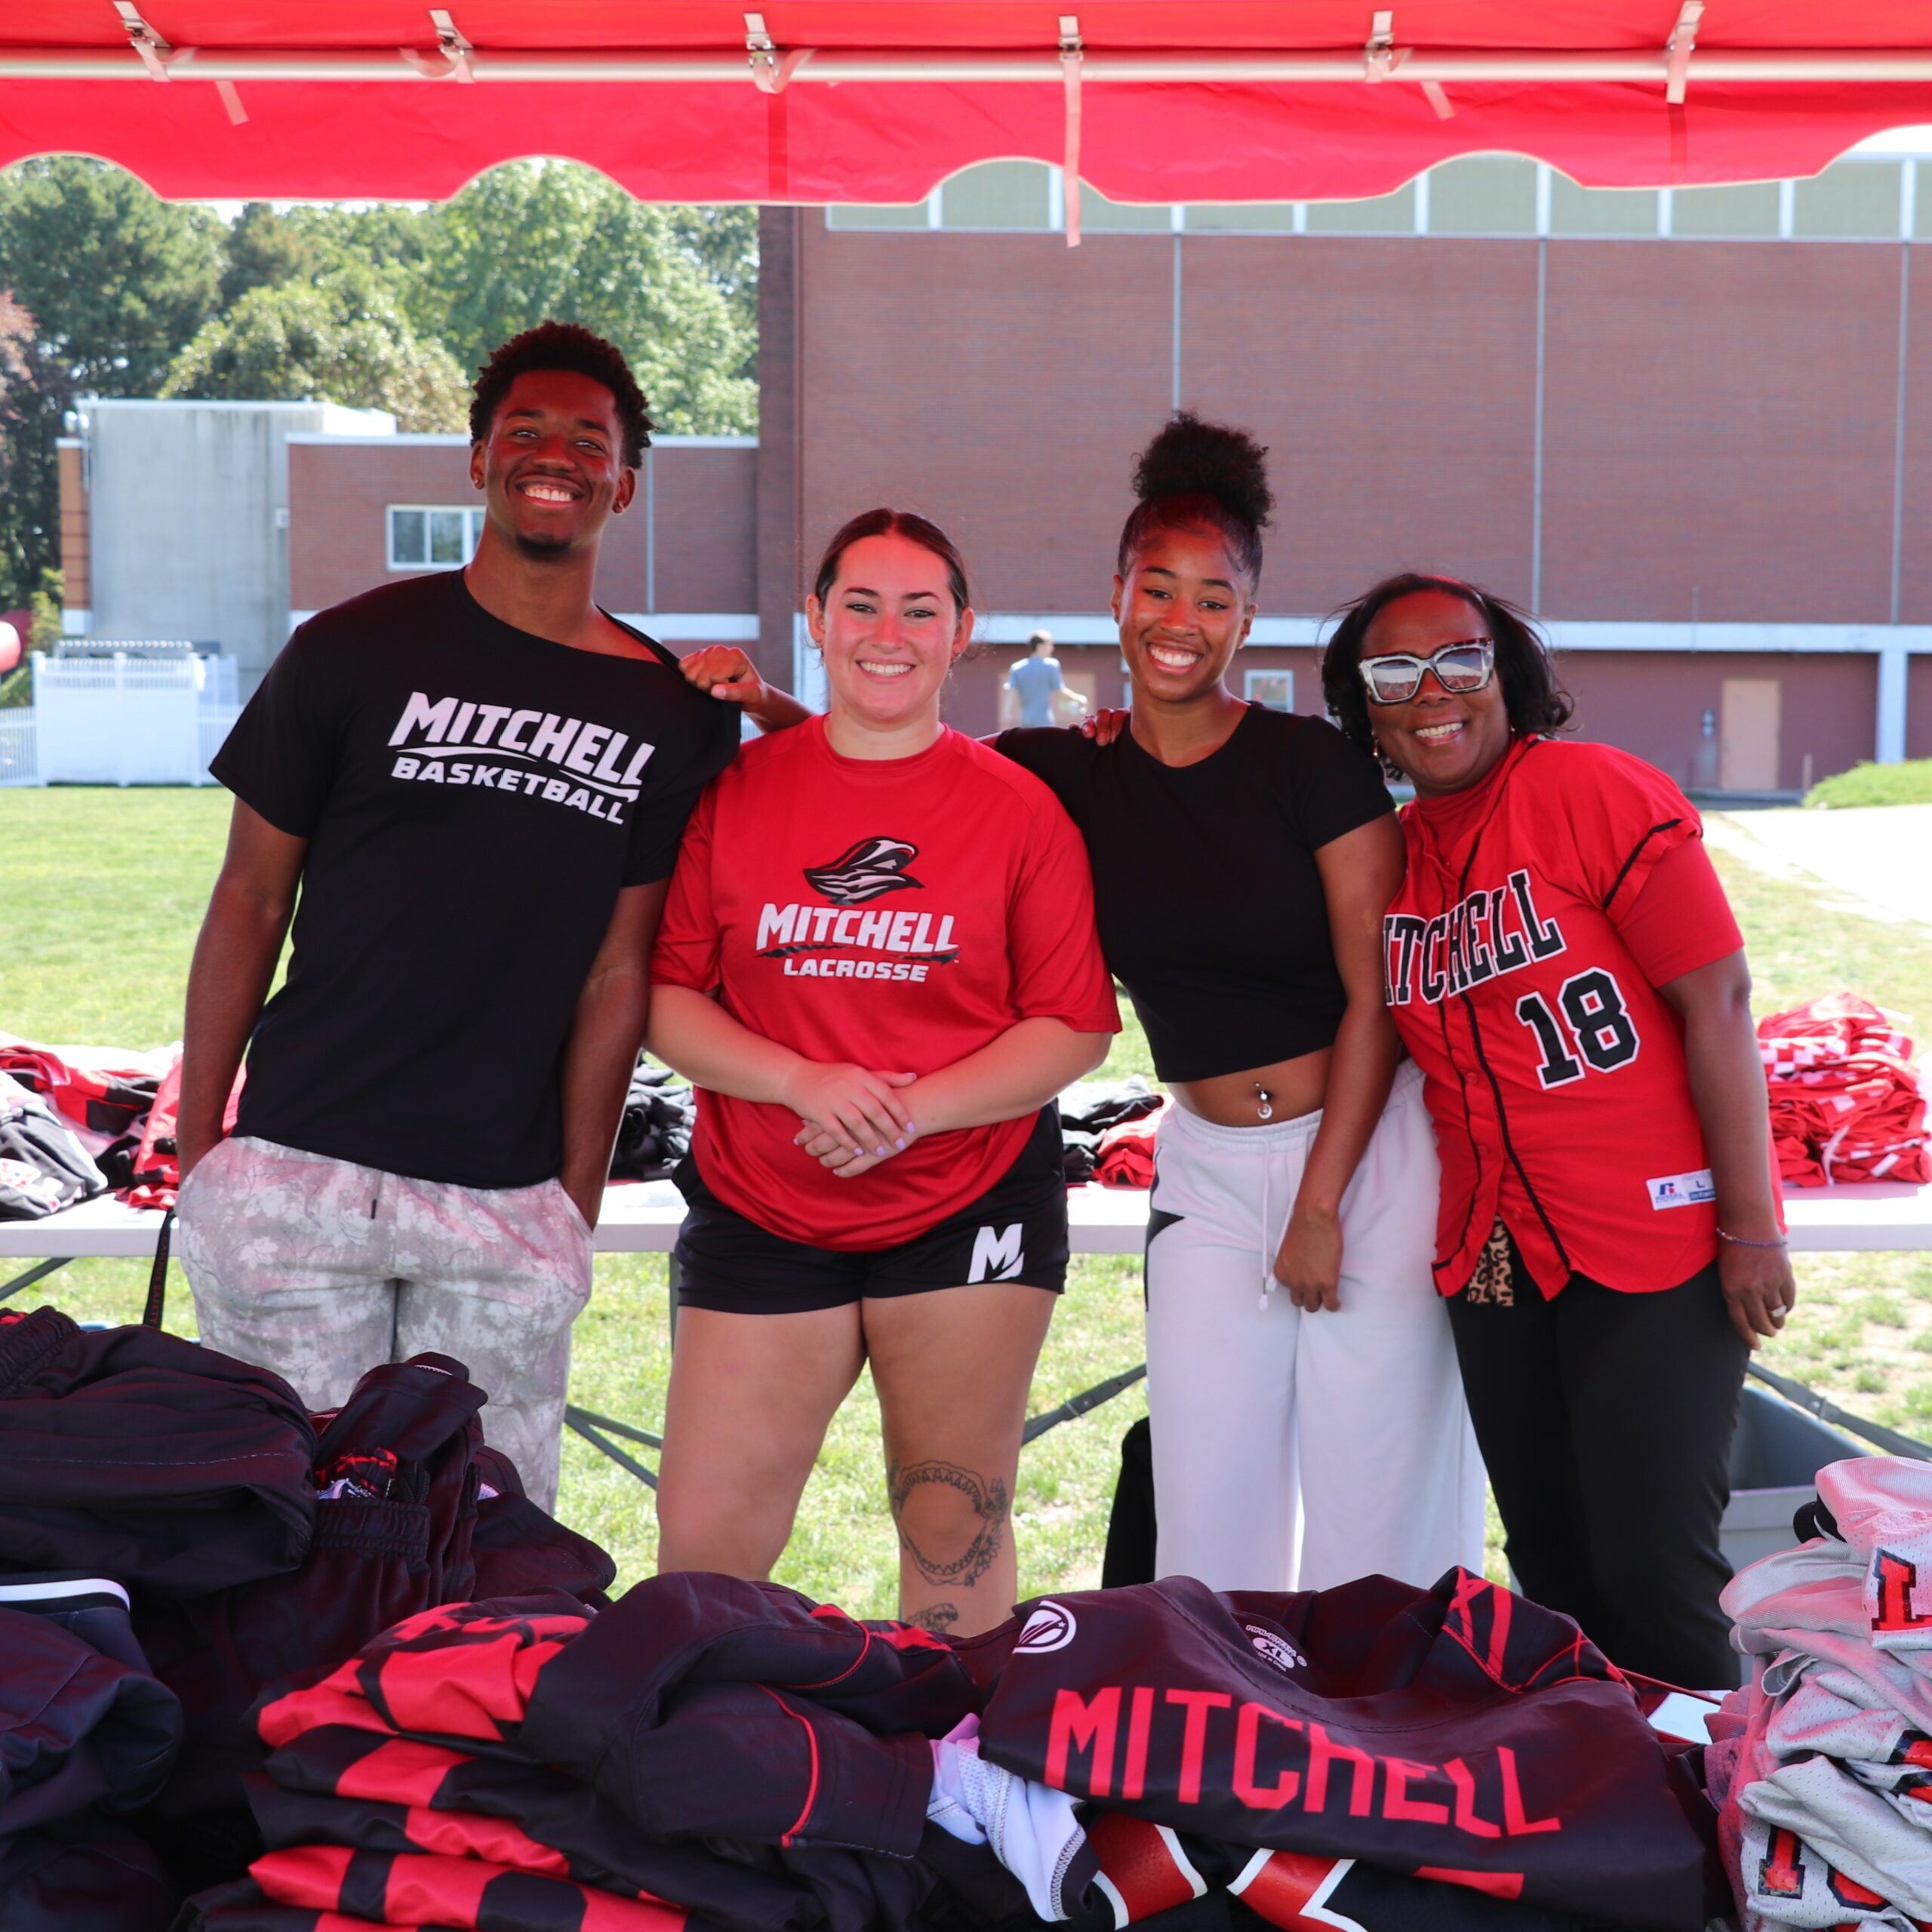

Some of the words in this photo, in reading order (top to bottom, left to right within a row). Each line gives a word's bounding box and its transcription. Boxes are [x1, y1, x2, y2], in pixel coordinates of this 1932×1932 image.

[387, 691, 656, 786] MITCHELL
[391, 757, 624, 825] BASKETBALL
[755, 903, 960, 953] MITCHELL
[1383, 869, 1567, 1006] ITCHELL
[783, 958, 929, 983] LACROSSE
[1515, 966, 1641, 1091] 18
[155, 1235, 167, 1281] CAMPUS
[967, 1223, 1025, 1284] M
[150, 1284, 162, 1324] SAFETY
[1261, 1641, 1285, 1663] XL
[1044, 1686, 1561, 1839] MITCHELL
